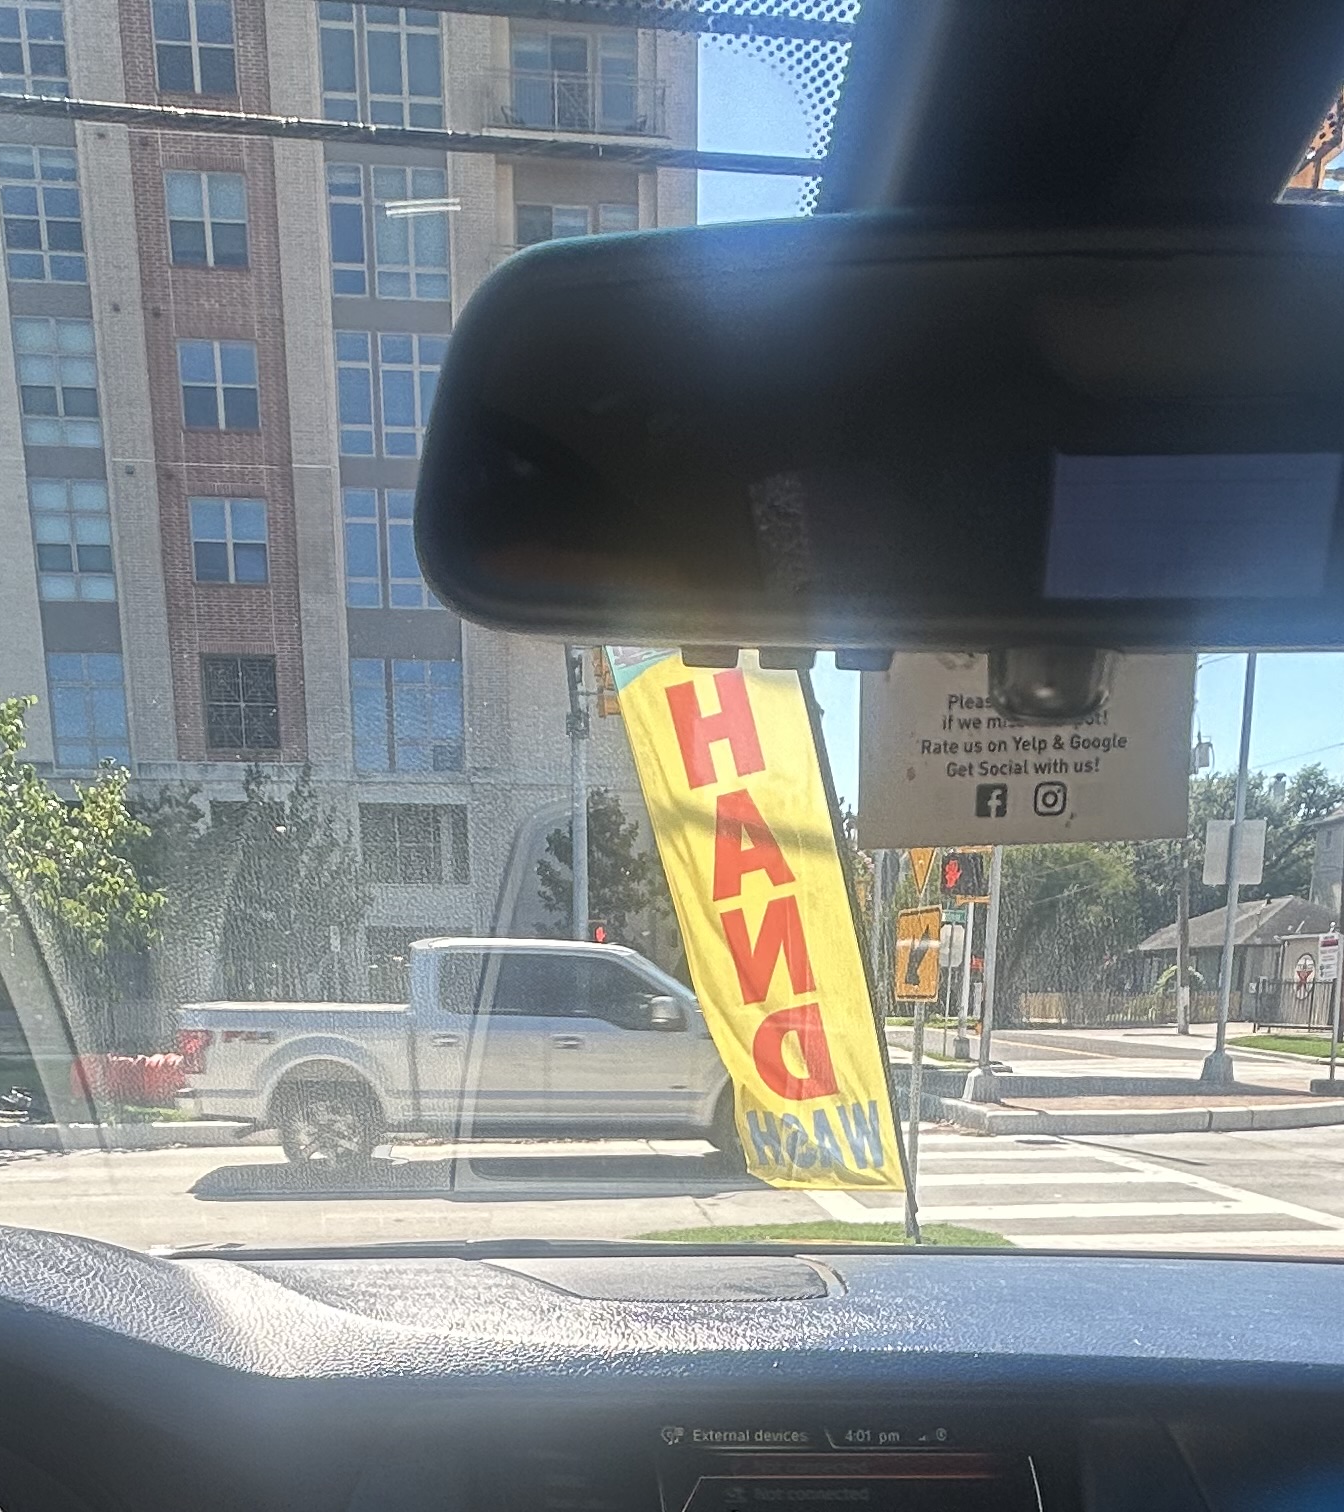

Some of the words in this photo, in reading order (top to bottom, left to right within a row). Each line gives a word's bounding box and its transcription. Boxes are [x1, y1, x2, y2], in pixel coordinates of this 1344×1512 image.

[948, 693, 993, 711] Pleas
[942, 714, 954, 731] if
[958, 717, 983, 730] we
[921, 738, 959, 755] Rate
[964, 741, 983, 754] us
[988, 740, 1008, 753] on
[1012, 735, 1048, 756] Yelp
[1052, 734, 1065, 750] &
[1070, 732, 1128, 753] Google
[946, 760, 975, 778] Get
[978, 758, 1029, 777] Social
[1034, 757, 1069, 775] with
[1074, 755, 1101, 774] us!
[692, 1429, 751, 1443] External
[754, 1429, 808, 1443] devices
[844, 1429, 872, 1443] 4:01
[878, 1431, 901, 1446] pm
